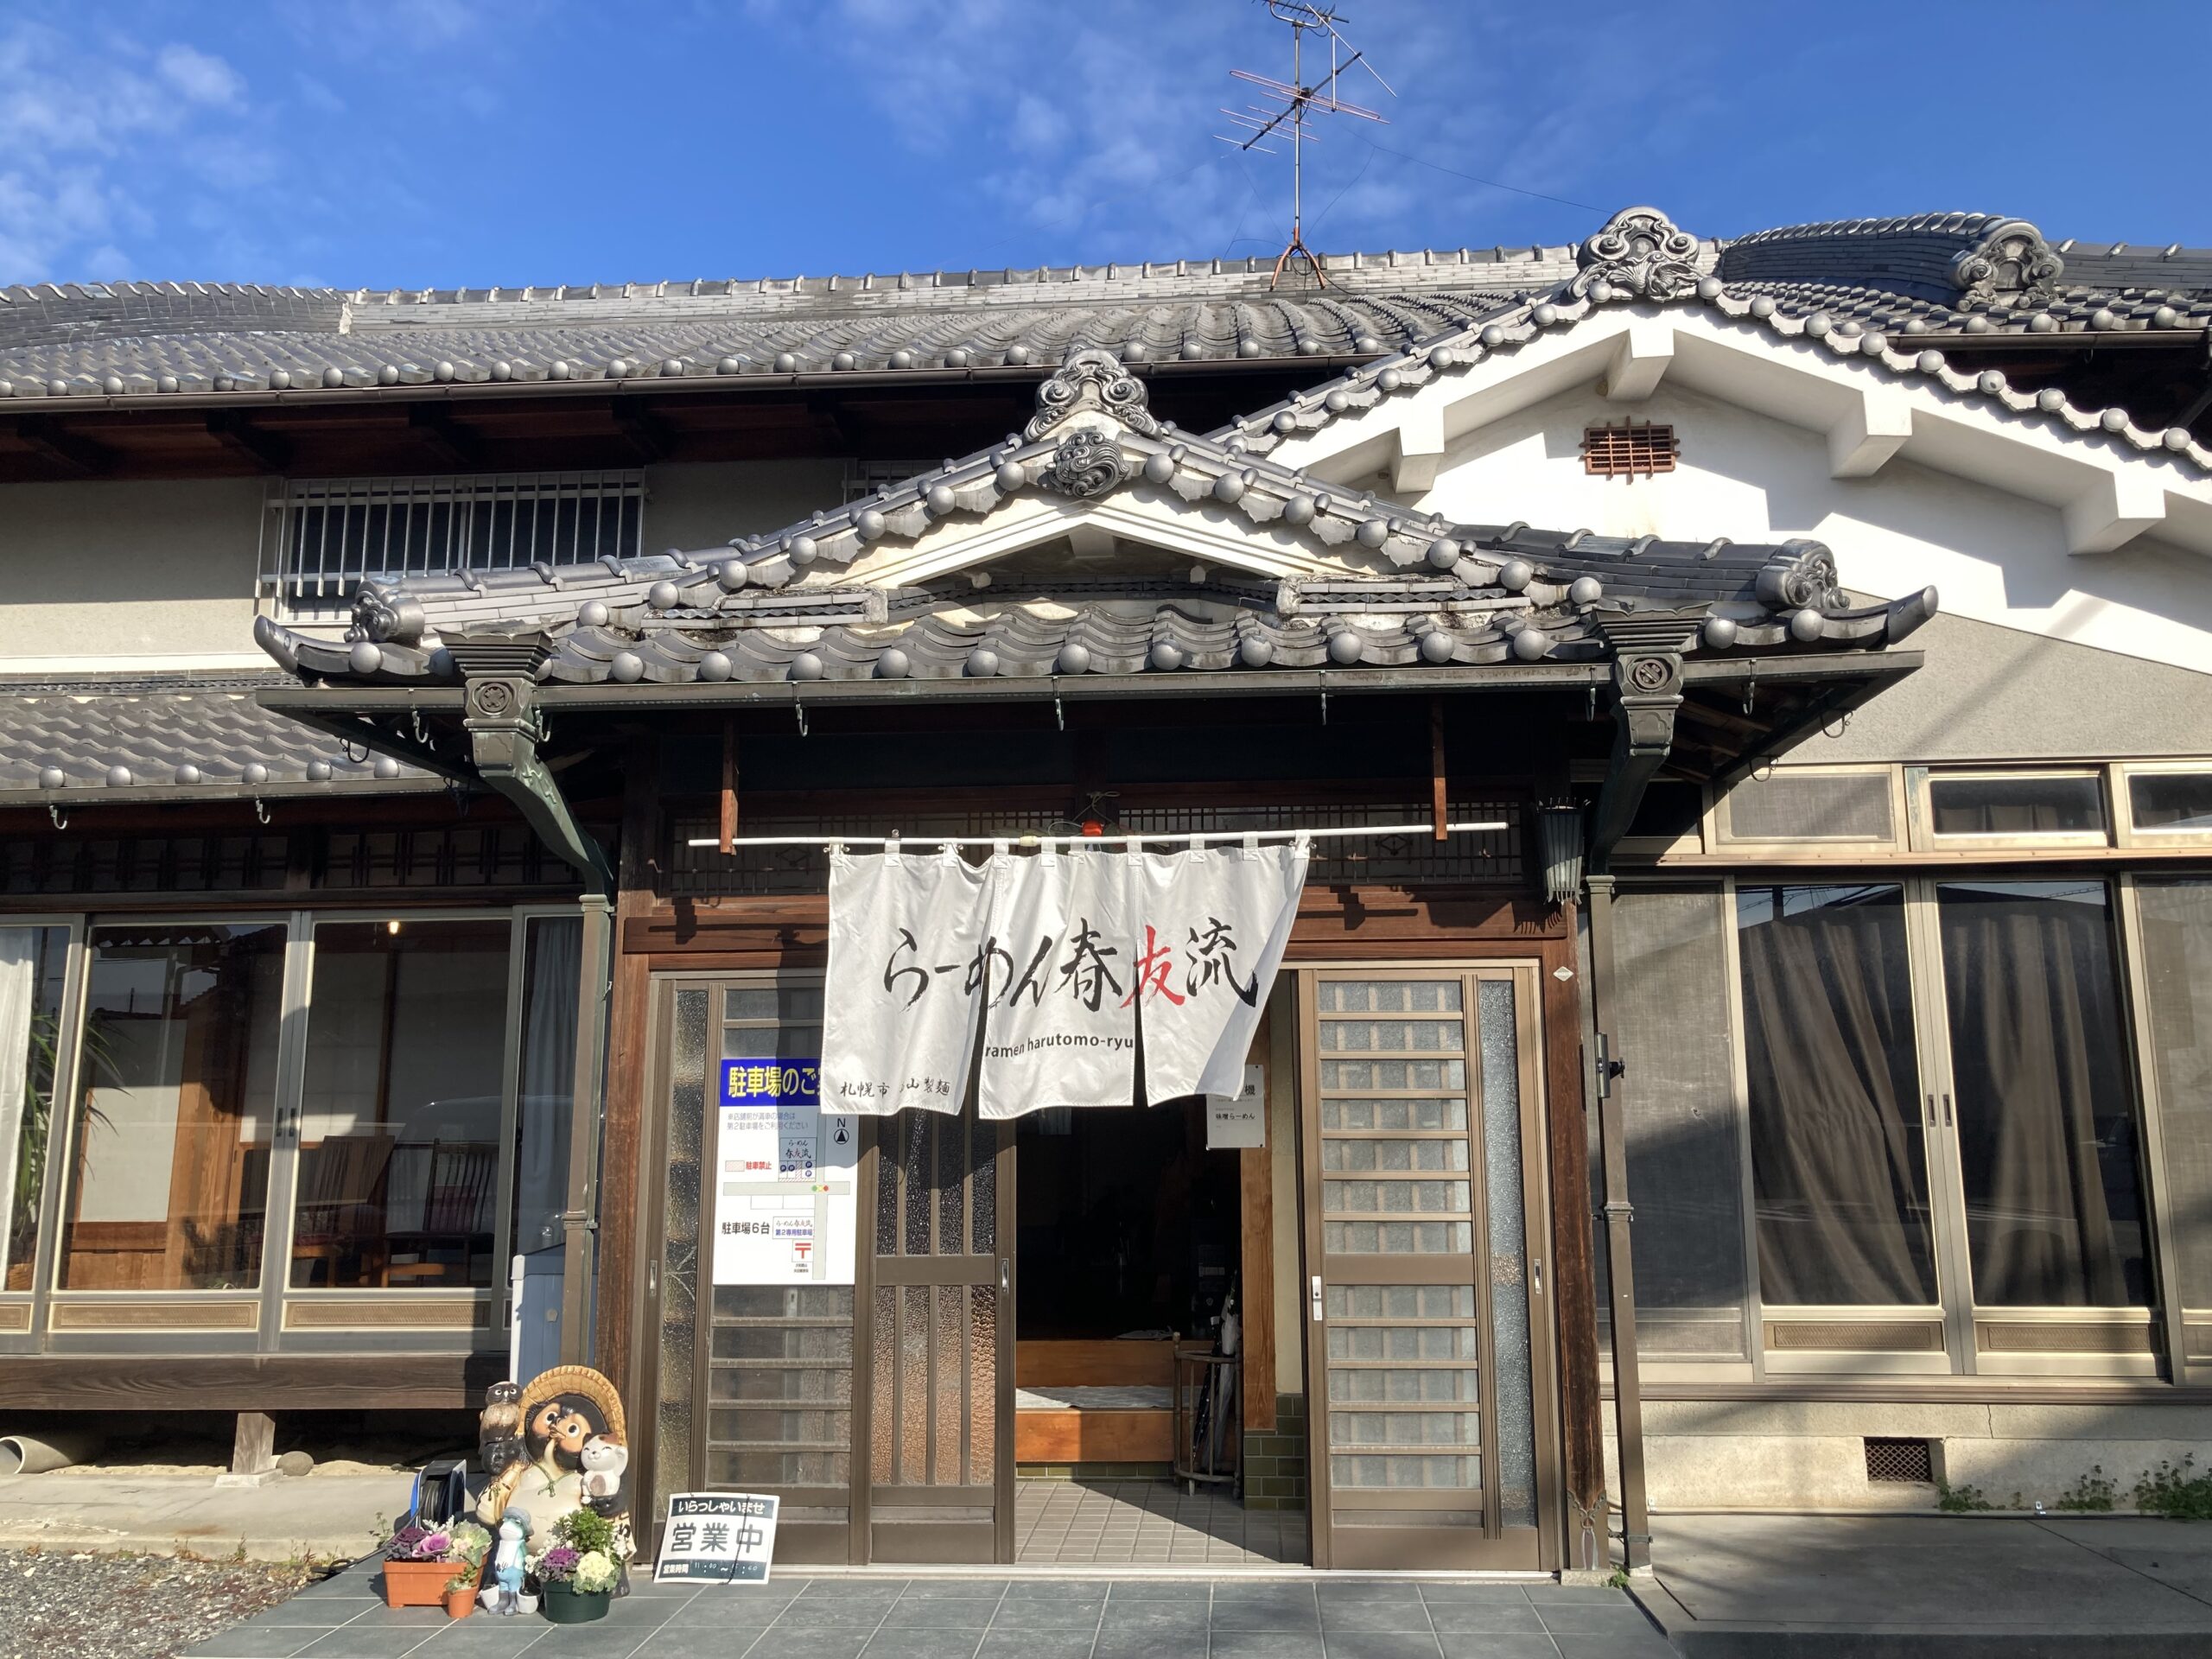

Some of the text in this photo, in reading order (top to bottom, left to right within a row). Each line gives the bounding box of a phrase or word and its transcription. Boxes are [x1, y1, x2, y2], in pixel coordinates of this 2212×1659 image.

[884, 917, 1259, 1012] らーめん春友流
[985, 1033, 1134, 1058] ramen harutomo-ryu
[728, 1066, 821, 1097] 駐車場のご
[836, 1117, 846, 1128] N
[746, 1161, 772, 1170] 駐車禁止
[721, 1222, 770, 1235] 駐車場6台
[678, 1500, 766, 1515] いらっしゃいませ
[671, 1522, 763, 1554] 営業中
